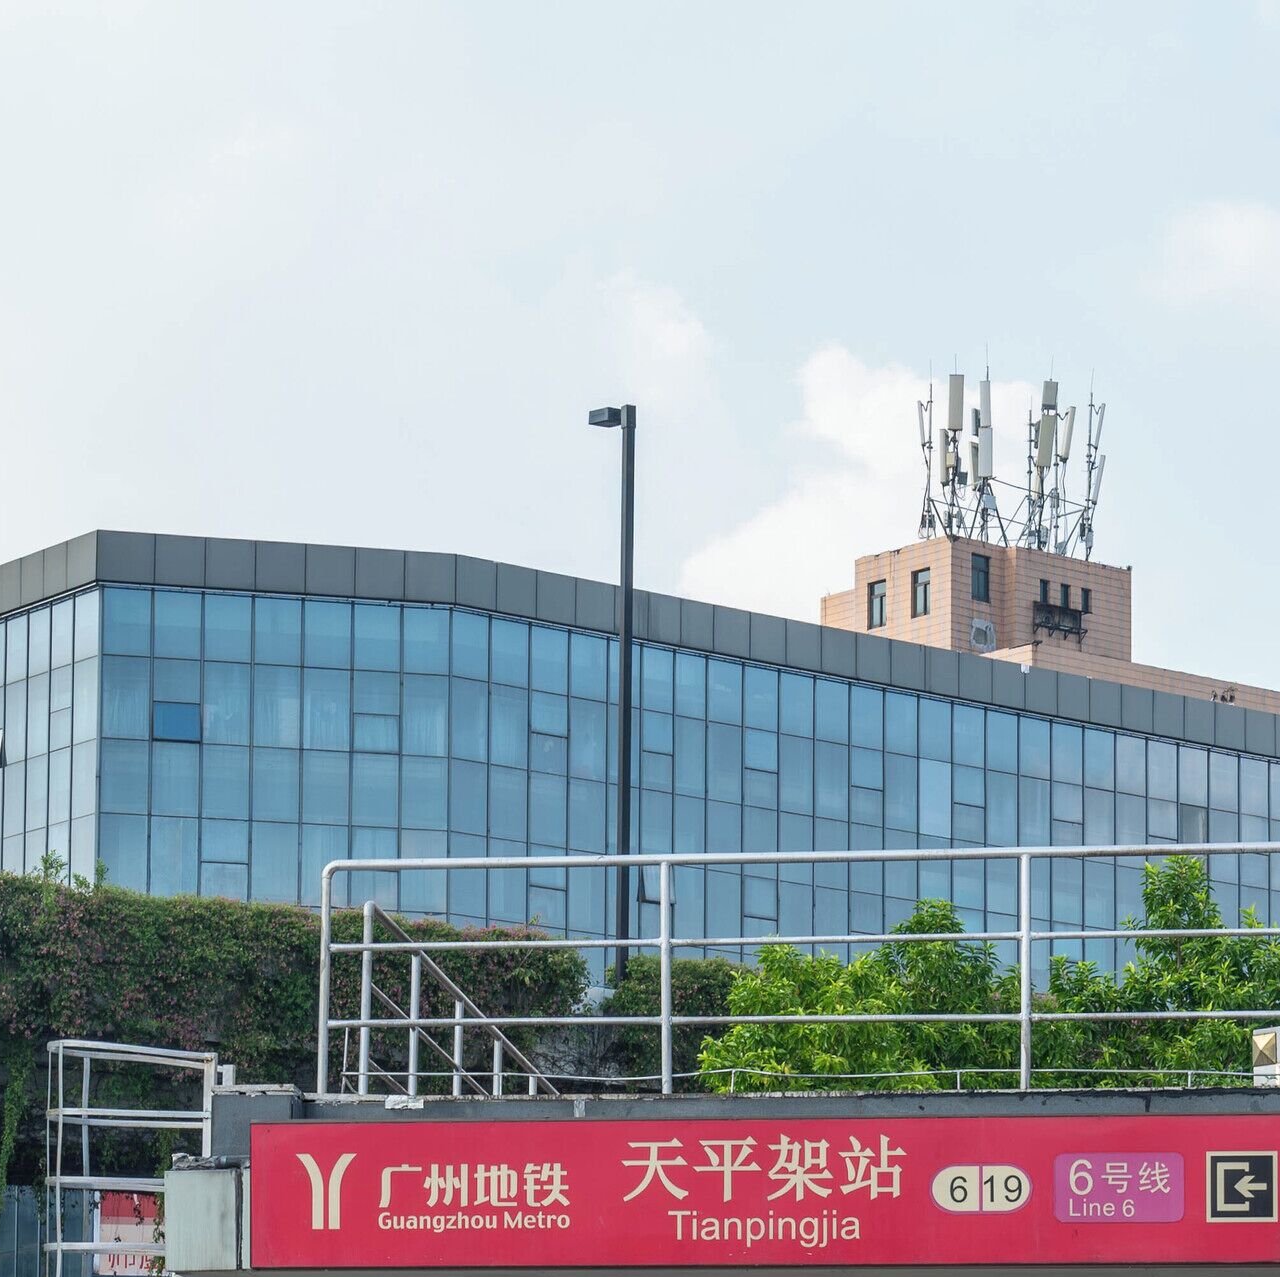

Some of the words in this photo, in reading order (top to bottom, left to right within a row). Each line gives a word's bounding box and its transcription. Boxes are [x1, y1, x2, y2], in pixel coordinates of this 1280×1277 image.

[378, 1162, 570, 1208] 广州地铁
[622, 1134, 908, 1203] 天平架站
[1069, 1159, 1171, 1196] 6号线
[949, 1175, 968, 1204] 6
[983, 1175, 1023, 1204] 19
[1069, 1198, 1116, 1217] Line
[1122, 1198, 1135, 1218] 6
[378, 1211, 498, 1233] Guangzhou
[503, 1211, 571, 1230] Metro
[668, 1209, 860, 1247] Tianpingjia
